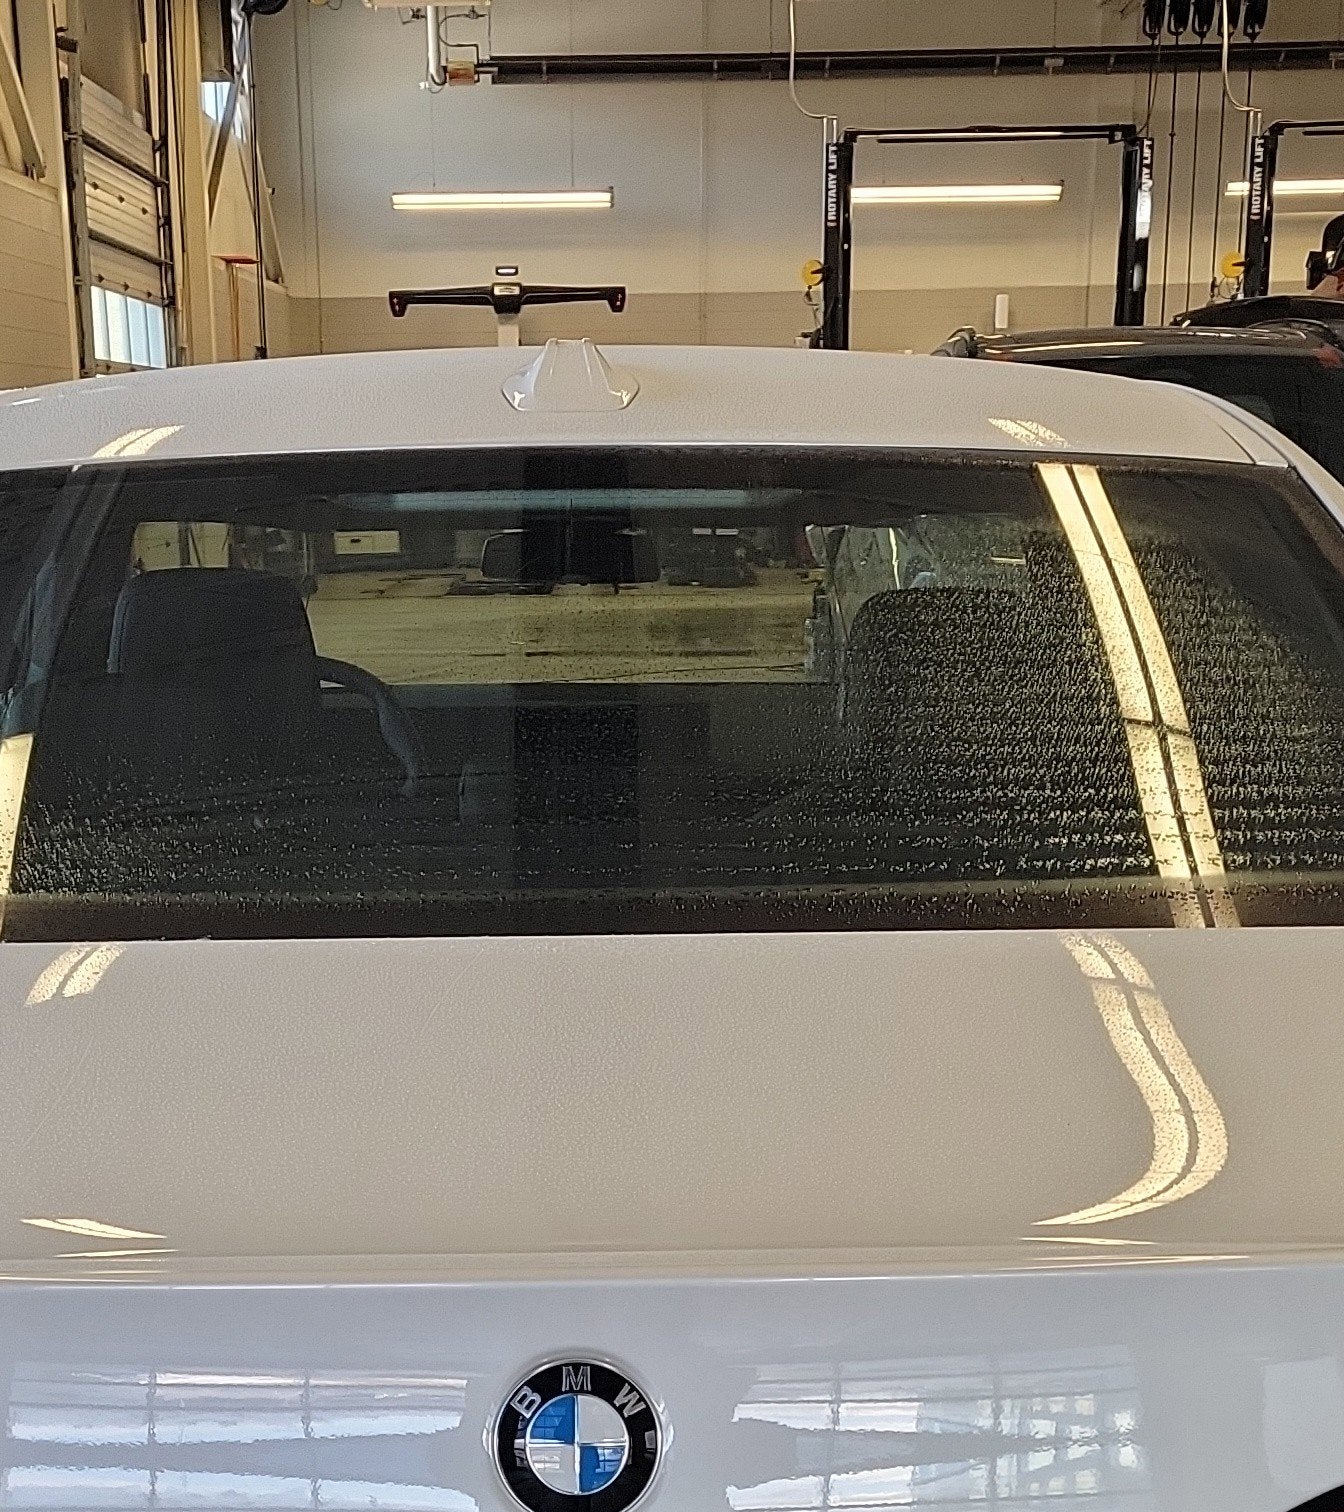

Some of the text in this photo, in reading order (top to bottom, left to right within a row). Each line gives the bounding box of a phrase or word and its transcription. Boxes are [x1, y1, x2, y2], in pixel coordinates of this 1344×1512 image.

[827, 144, 838, 220] ROTARY LIFT
[1143, 138, 1153, 164] LIFT
[1251, 137, 1265, 213] ROTARY LIFT
[510, 1365, 647, 1419] BMW
